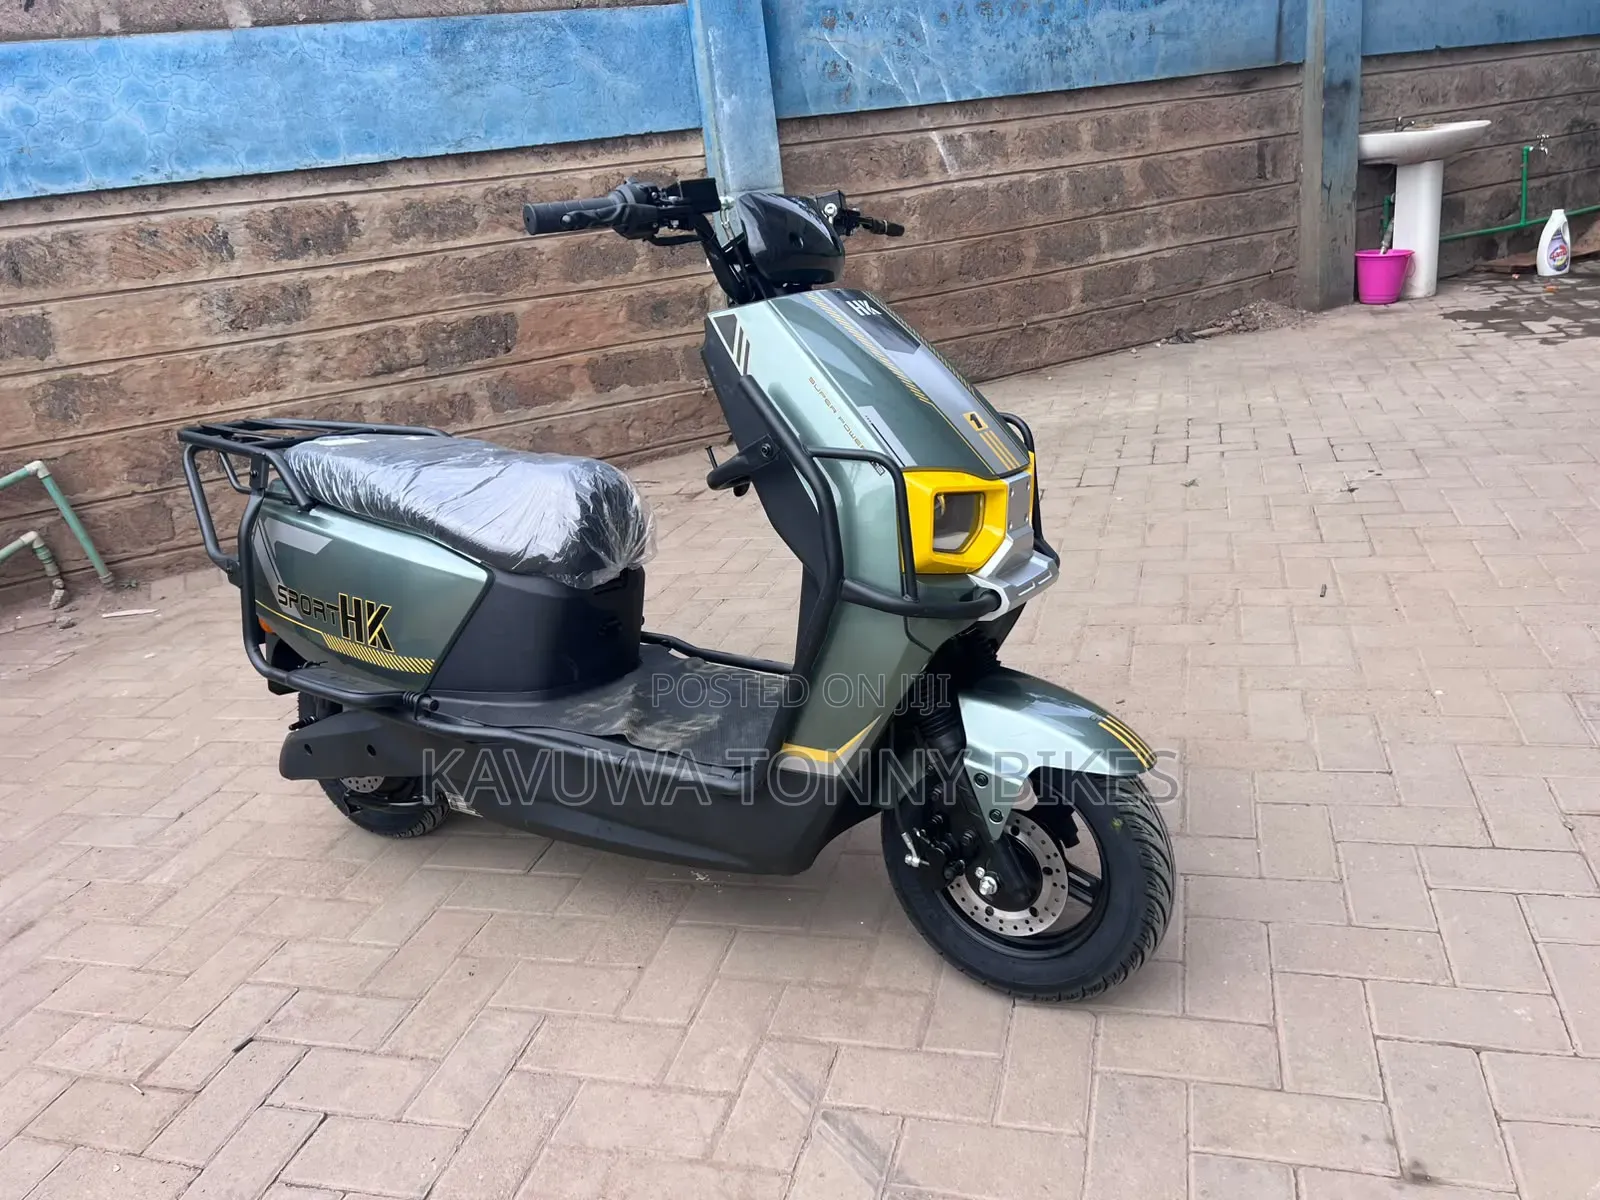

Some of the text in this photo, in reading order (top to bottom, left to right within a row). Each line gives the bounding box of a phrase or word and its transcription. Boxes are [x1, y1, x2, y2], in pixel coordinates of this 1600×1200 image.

[845, 300, 882, 316] HK
[808, 376, 837, 413] SUPER
[277, 583, 395, 653] SPORT HK
